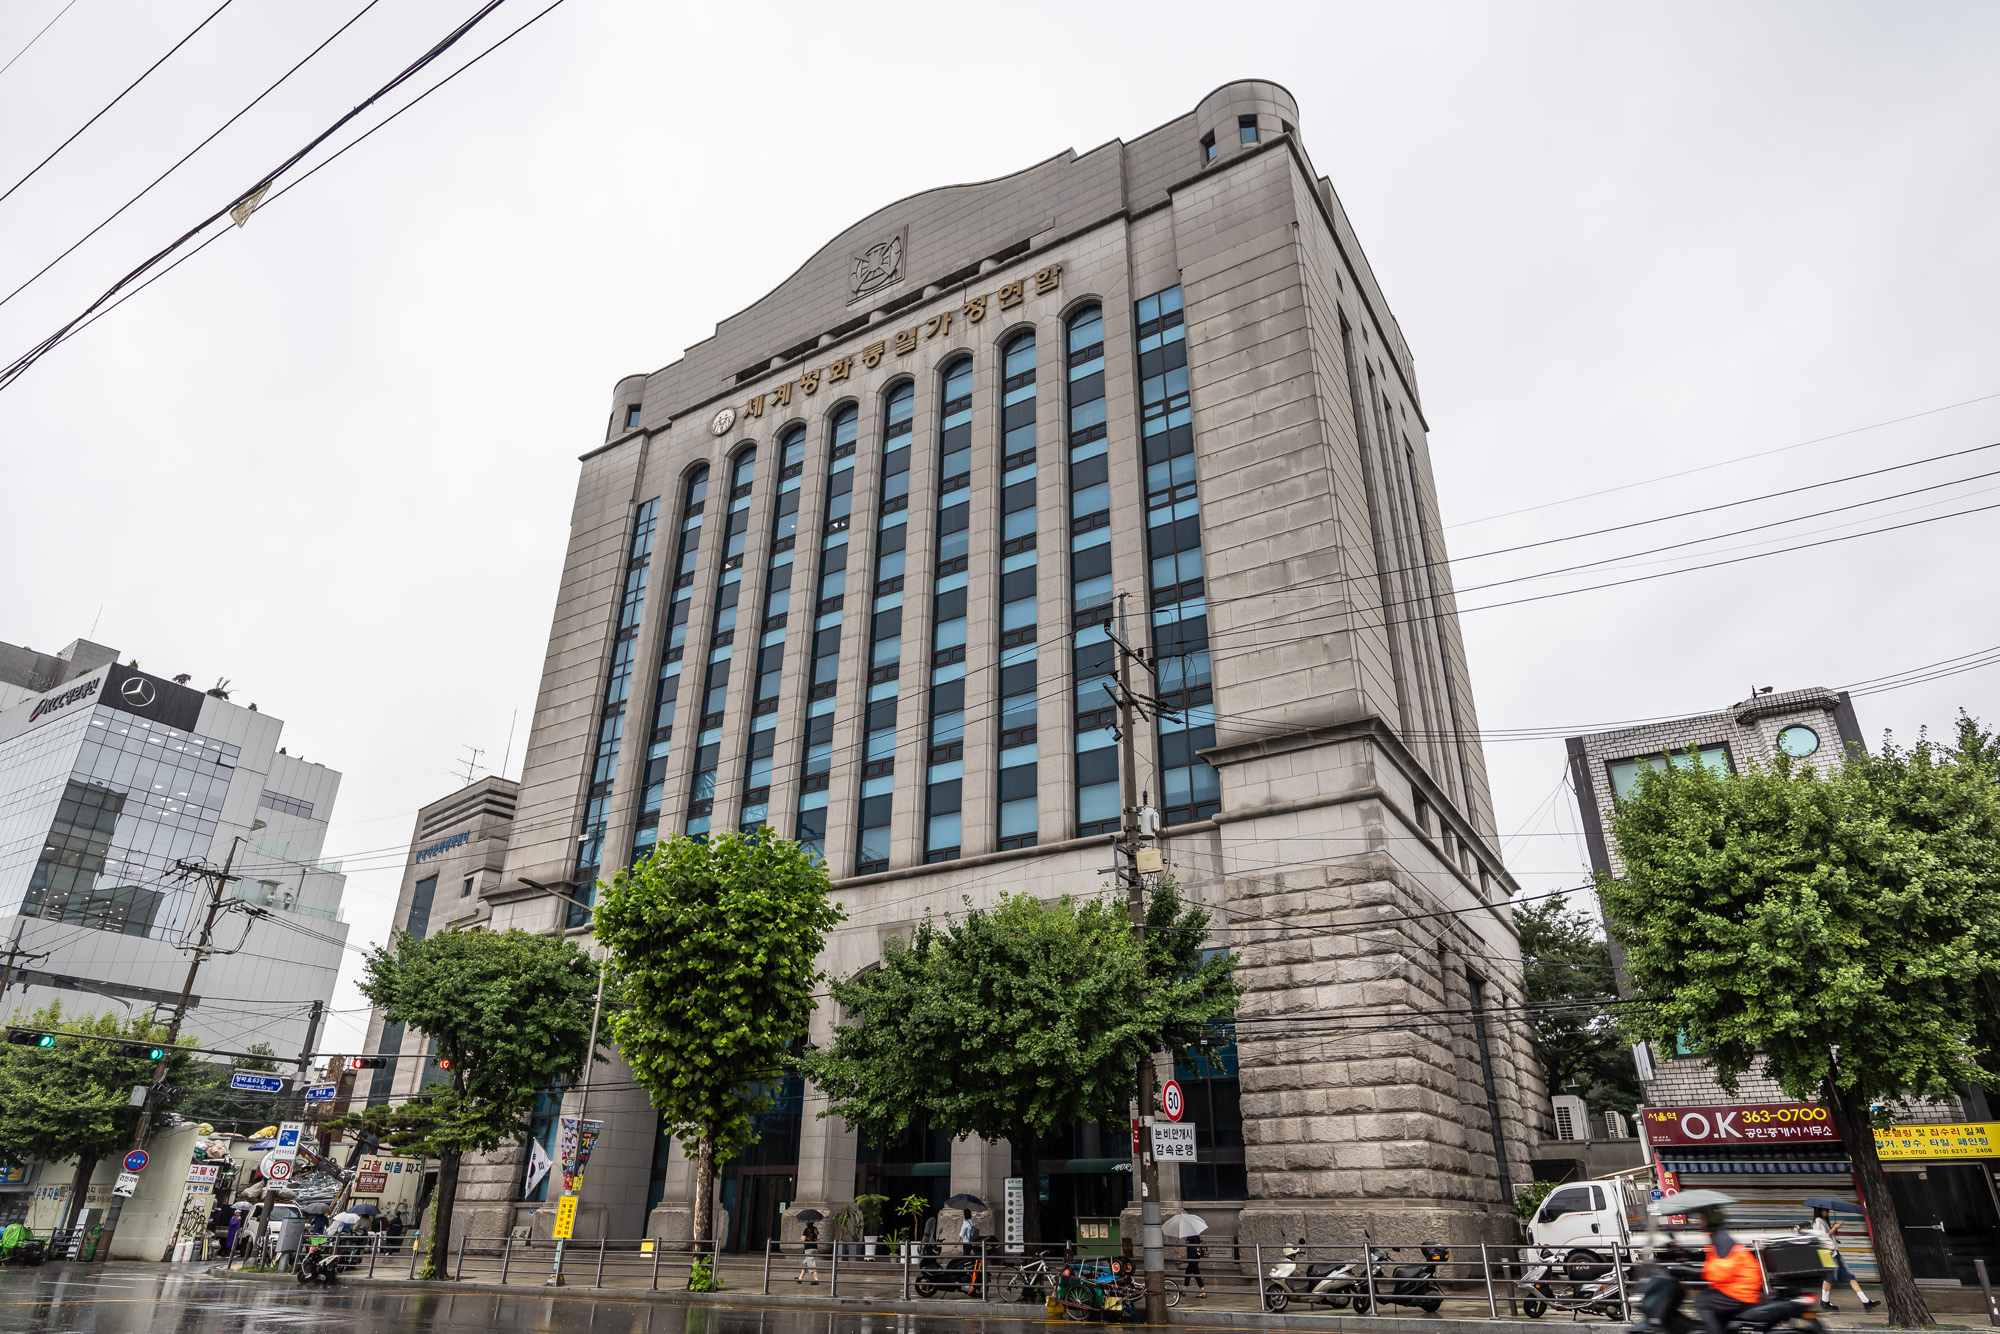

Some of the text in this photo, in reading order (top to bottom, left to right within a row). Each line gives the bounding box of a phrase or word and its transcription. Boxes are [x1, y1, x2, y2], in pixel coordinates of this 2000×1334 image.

[743, 263, 1062, 418] 세계평화통일가정연합
[1168, 1092, 1179, 1110] 50
[1648, 1112, 1677, 1122] 서울역
[1741, 1107, 1827, 1123] 363-0700
[1681, 1111, 1743, 1140] O.K
[1744, 1125, 1833, 1138] 공인중개사 사무소
[1916, 1128, 1926, 1137] 및
[1929, 1127, 1961, 1137] 집수리
[1964, 1127, 1986, 1136] 일체
[1957, 1137, 1990, 1146] 페인팅
[1155, 1144, 1194, 1157] 감속운행
[191, 1166, 217, 1177] 고물상
[273, 1165, 287, 1175] 30
[361, 1160, 382, 1172] 고철
[384, 1161, 403, 1174] 비철
